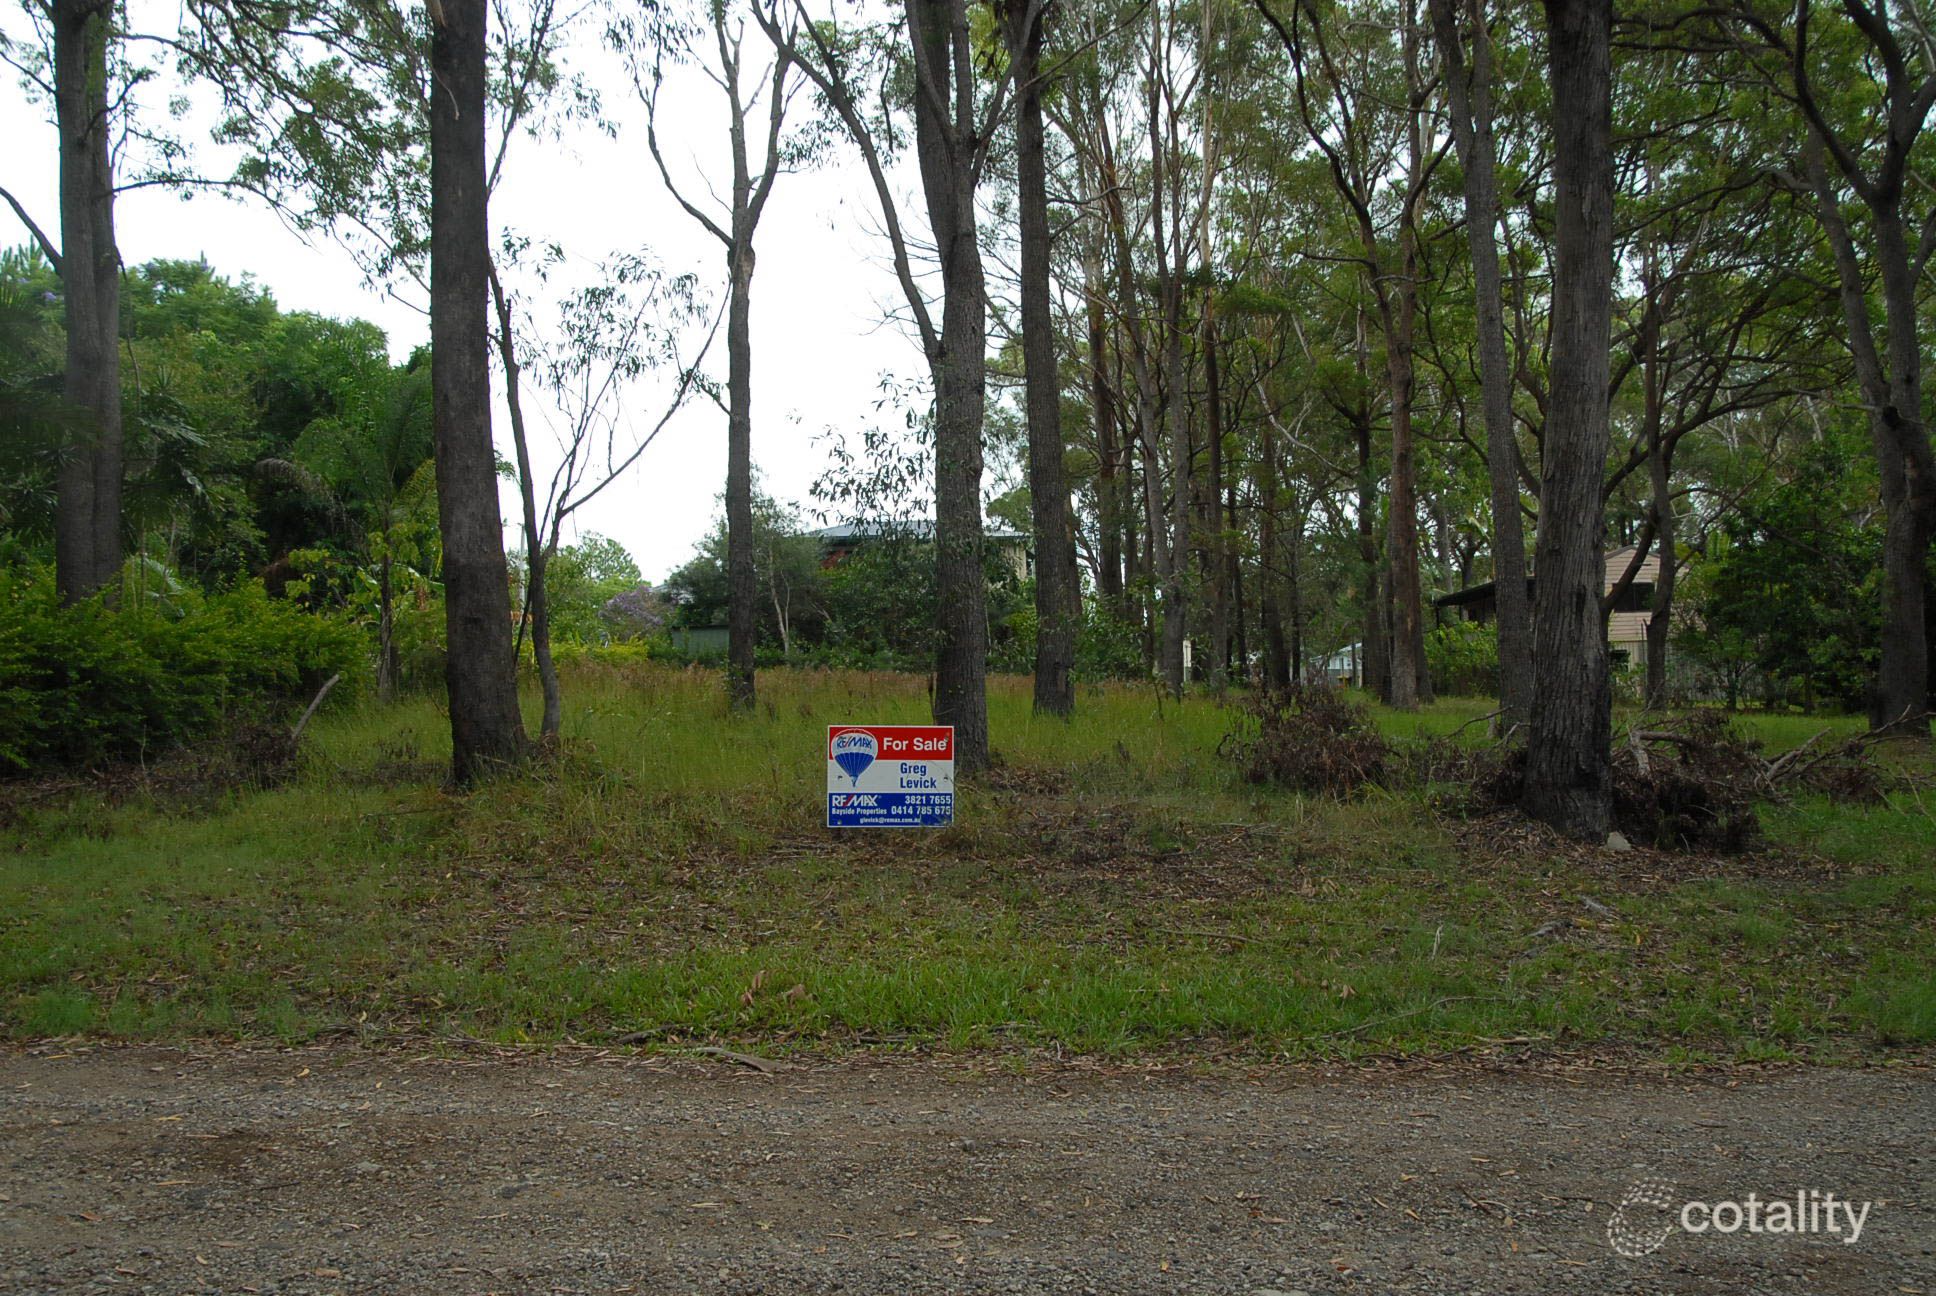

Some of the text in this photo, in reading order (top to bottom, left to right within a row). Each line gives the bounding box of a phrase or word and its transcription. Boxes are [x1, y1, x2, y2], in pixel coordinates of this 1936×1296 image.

[883, 738, 947, 751] For Sale
[900, 762, 926, 776] Greg
[900, 777, 936, 789] Levick
[905, 795, 951, 804] 3821 7655
[891, 806, 951, 815] 0414 785 675
